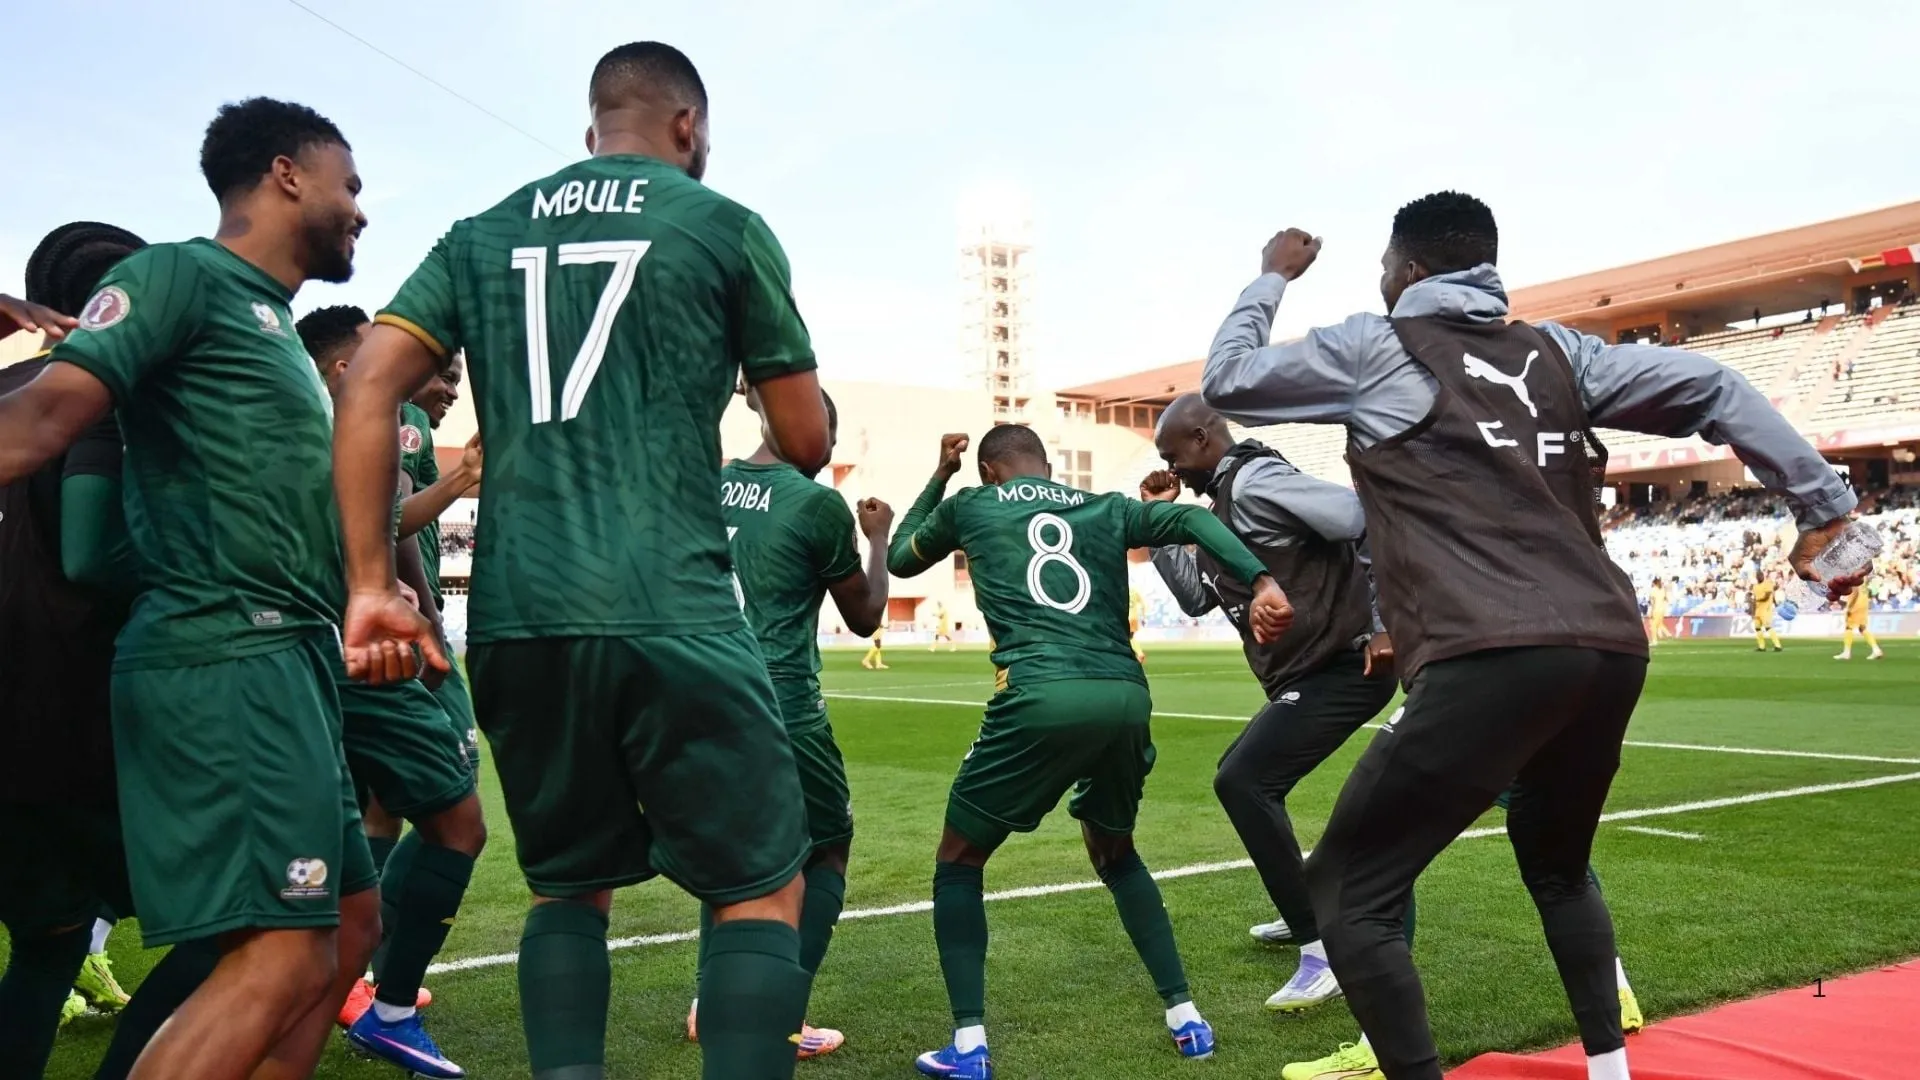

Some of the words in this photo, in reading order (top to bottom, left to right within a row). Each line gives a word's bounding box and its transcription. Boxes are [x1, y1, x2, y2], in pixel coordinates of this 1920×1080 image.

[531, 179, 649, 219] MBULE
[511, 240, 652, 424] 17
[997, 484, 1085, 507] MOREMI
[1026, 512, 1092, 614] 8
